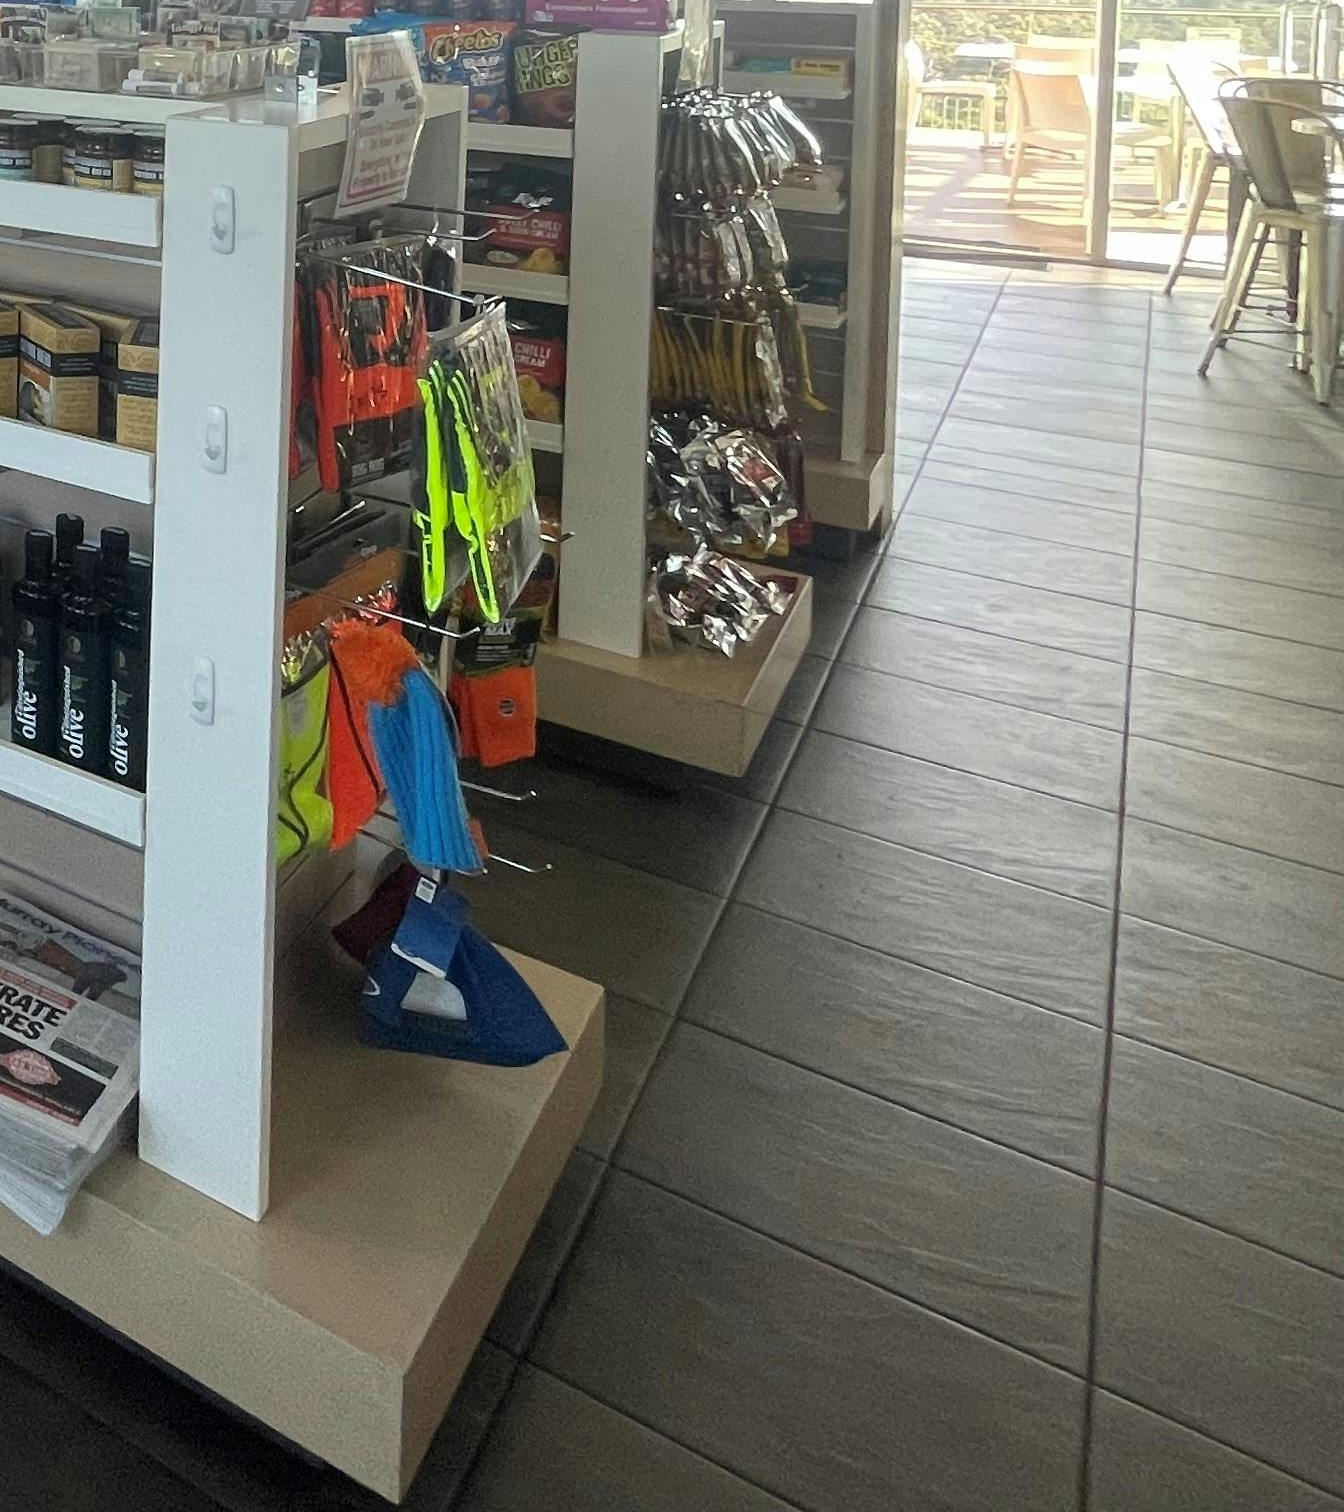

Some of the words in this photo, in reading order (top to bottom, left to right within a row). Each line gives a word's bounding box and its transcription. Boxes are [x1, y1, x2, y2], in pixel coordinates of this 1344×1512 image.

[17, 690, 38, 740] olive
[62, 708, 85, 759] olive
[110, 724, 129, 776] olive
